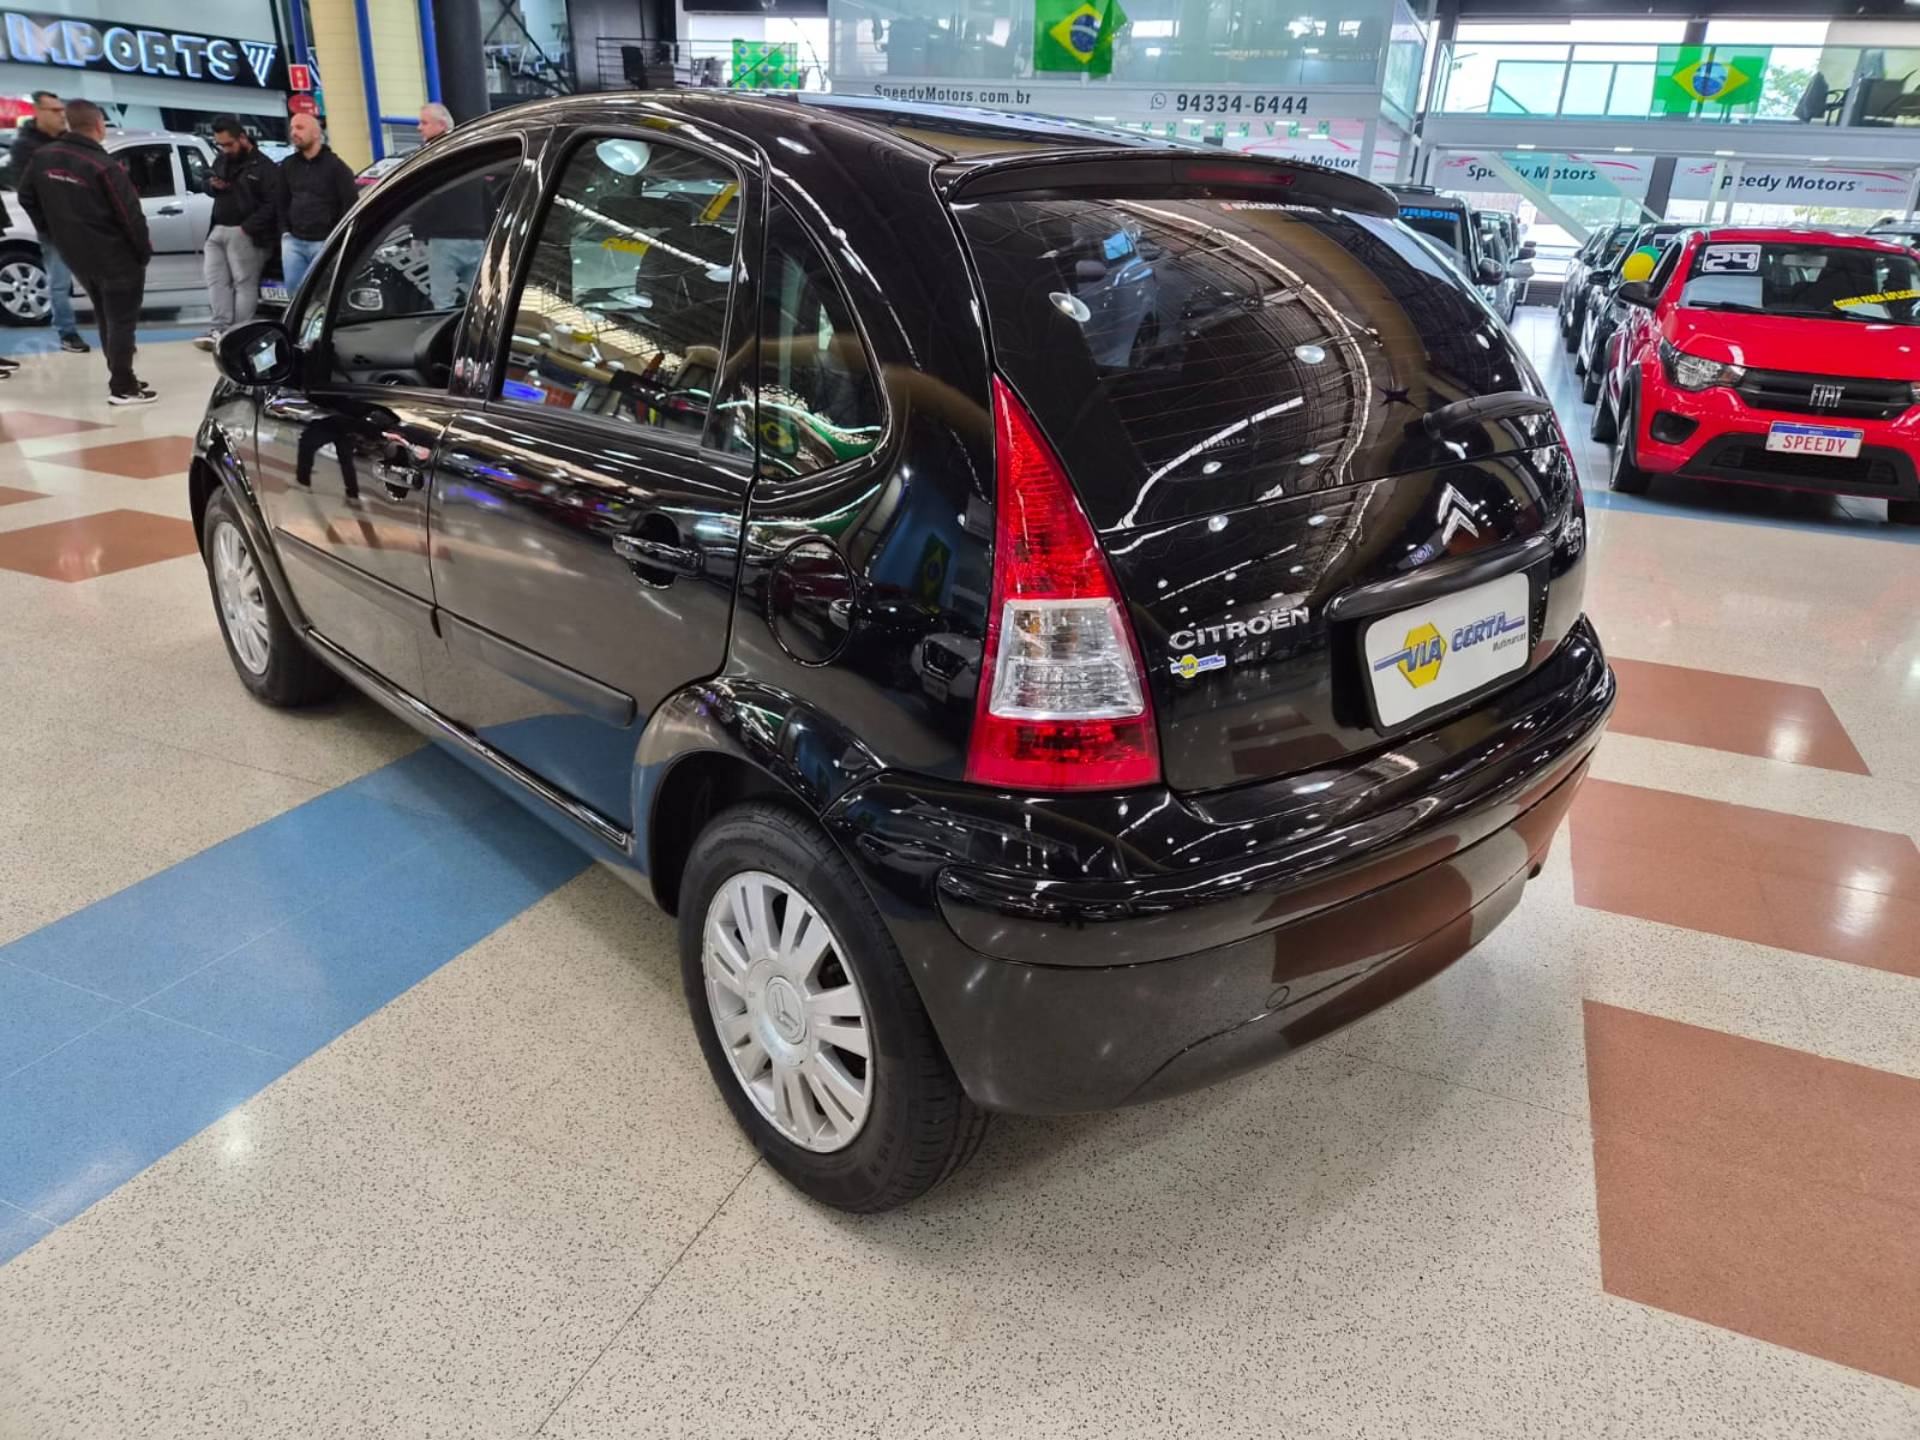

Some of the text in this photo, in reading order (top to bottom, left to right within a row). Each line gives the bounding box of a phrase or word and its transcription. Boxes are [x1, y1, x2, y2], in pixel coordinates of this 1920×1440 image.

[4, 12, 240, 81] IMPORTS
[1176, 93, 1309, 115] 94334-6444
[1311, 155, 1359, 170] Motor
[1534, 165, 1597, 181] Motors
[1785, 175, 1857, 192] Motors
[1704, 251, 1757, 271] 24
[1808, 384, 1846, 408] FIAT
[1782, 434, 1847, 453] SPEEDY
[1168, 606, 1310, 651] CITROËN
[1402, 635, 1442, 673] VIA
